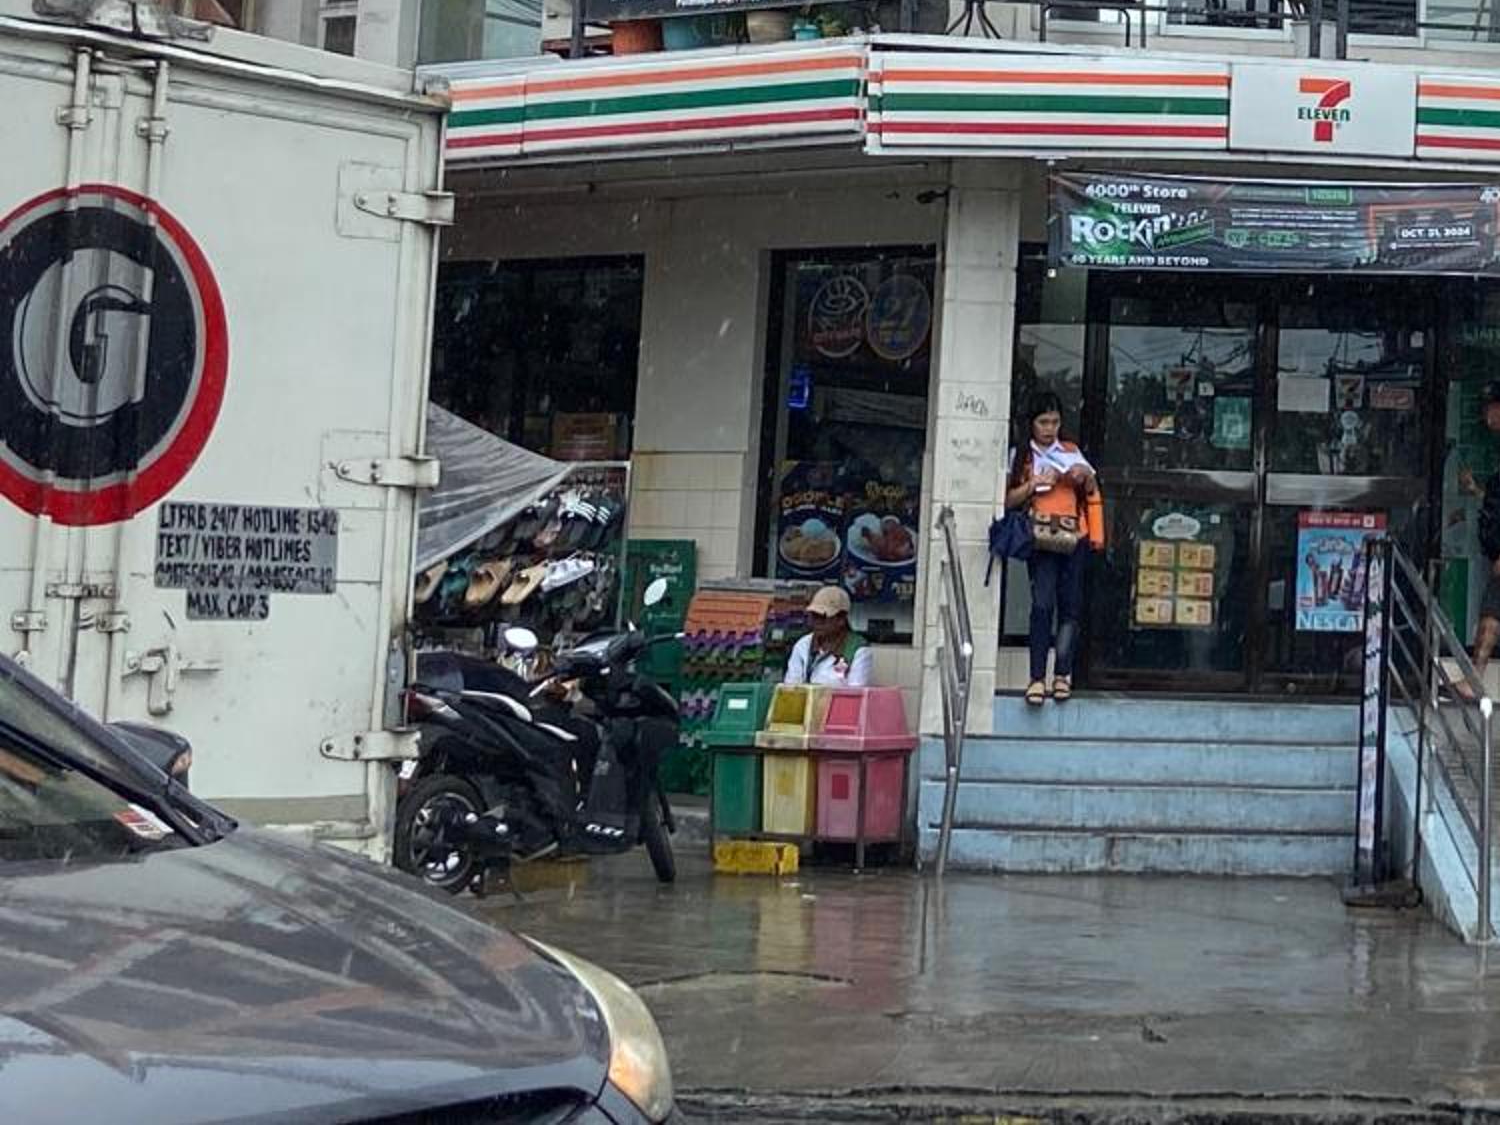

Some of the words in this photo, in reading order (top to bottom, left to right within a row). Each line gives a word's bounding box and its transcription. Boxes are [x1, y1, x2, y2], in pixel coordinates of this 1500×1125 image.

[1143, 185, 1188, 198] Store
[1088, 255, 1127, 265] YEARS
[1128, 256, 1156, 265] AND
[1158, 256, 1209, 266] BEYOND
[161, 503, 207, 530] LTFRB
[210, 506, 239, 533] 24/7
[158, 533, 191, 558] TEXT
[202, 535, 241, 560] VIBER
[245, 538, 311, 562] HOTLINES
